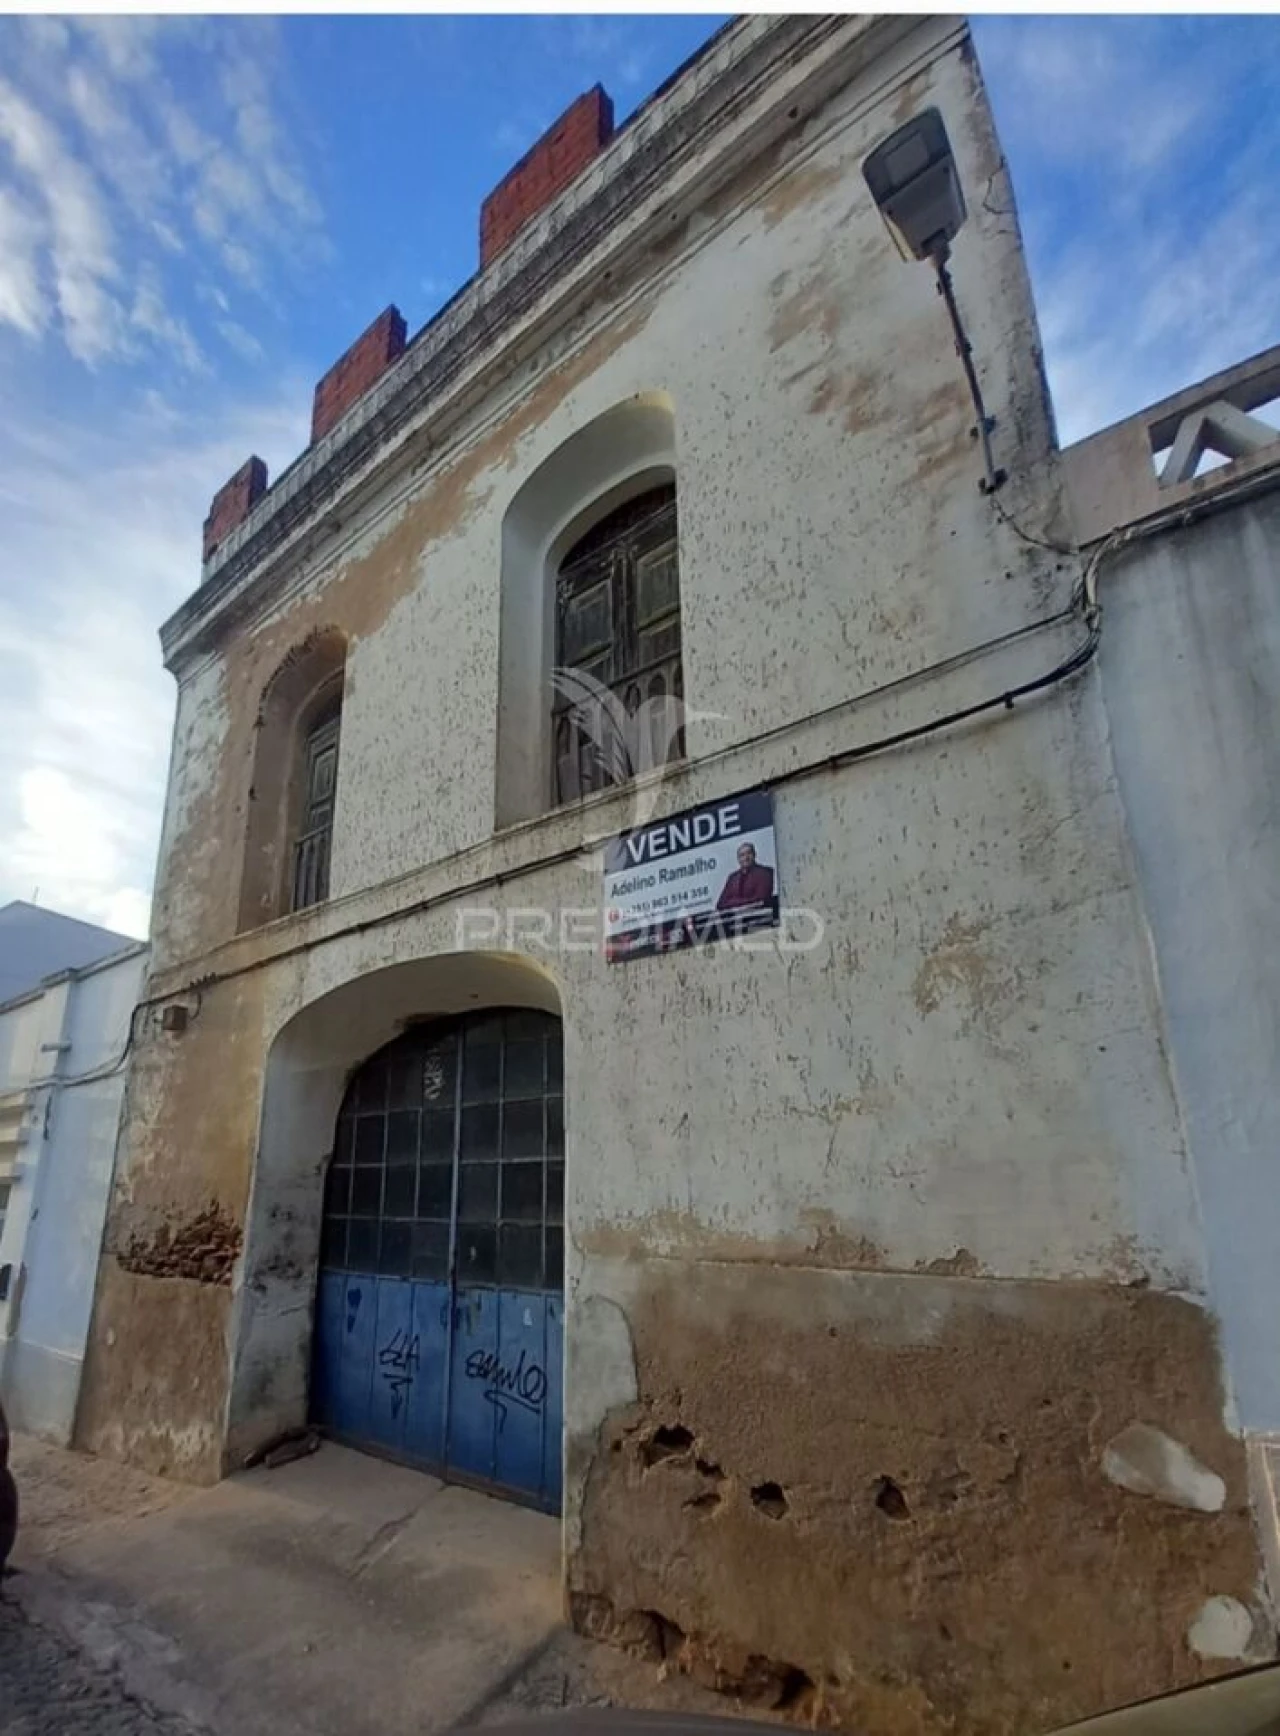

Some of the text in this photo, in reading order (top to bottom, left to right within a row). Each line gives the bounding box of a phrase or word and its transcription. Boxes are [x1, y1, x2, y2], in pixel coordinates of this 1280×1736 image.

[627, 803, 741, 863] VENDE
[610, 857, 717, 898] Adelino Ramalho
